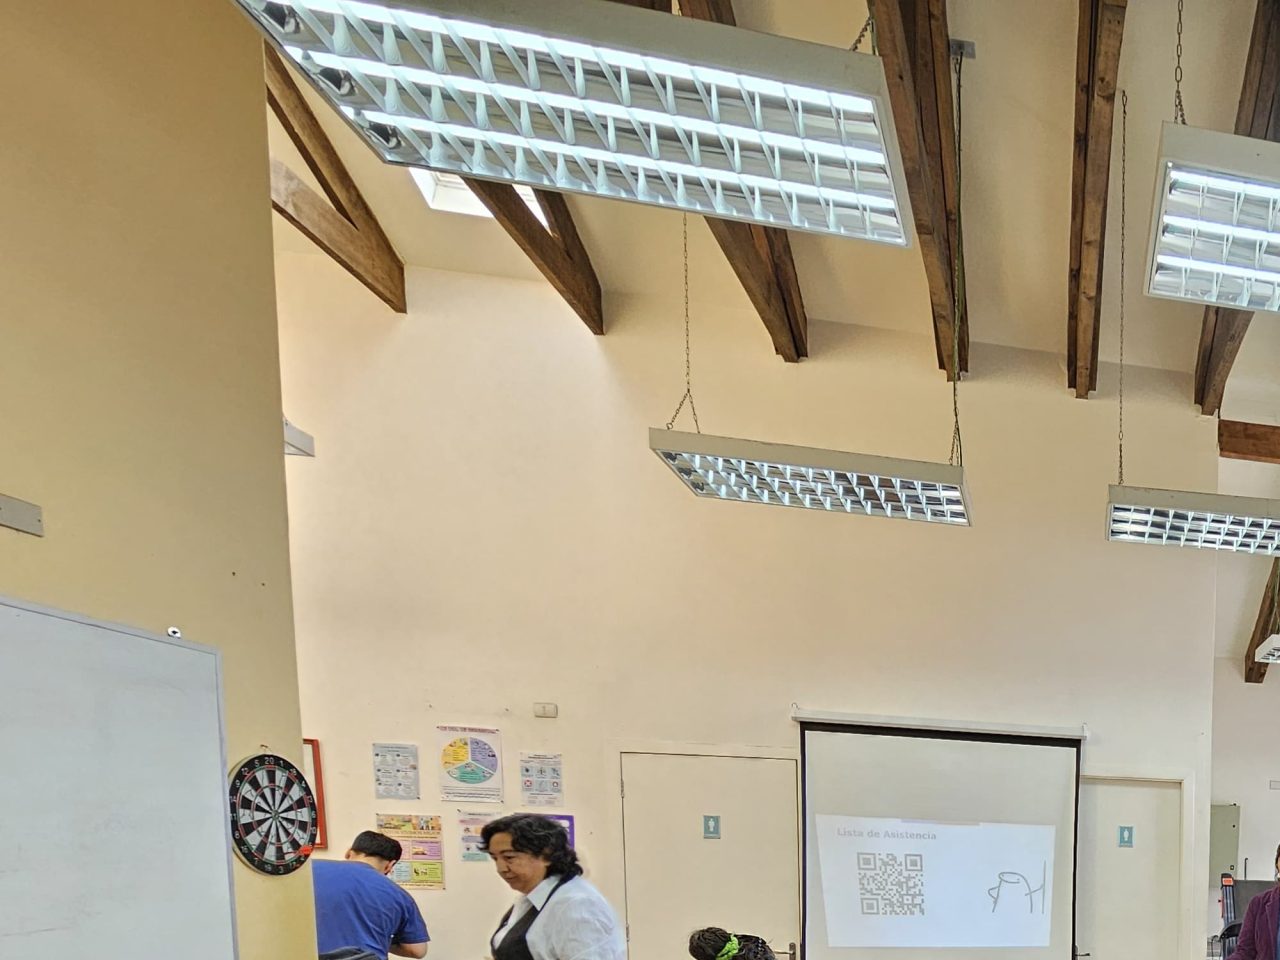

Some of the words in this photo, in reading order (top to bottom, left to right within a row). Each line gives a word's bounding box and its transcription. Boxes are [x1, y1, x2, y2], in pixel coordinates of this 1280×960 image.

[264, 756, 274, 765] 20
[837, 828, 864, 837] Lista
[867, 829, 880, 838] de
[883, 830, 937, 840] Asistencia
